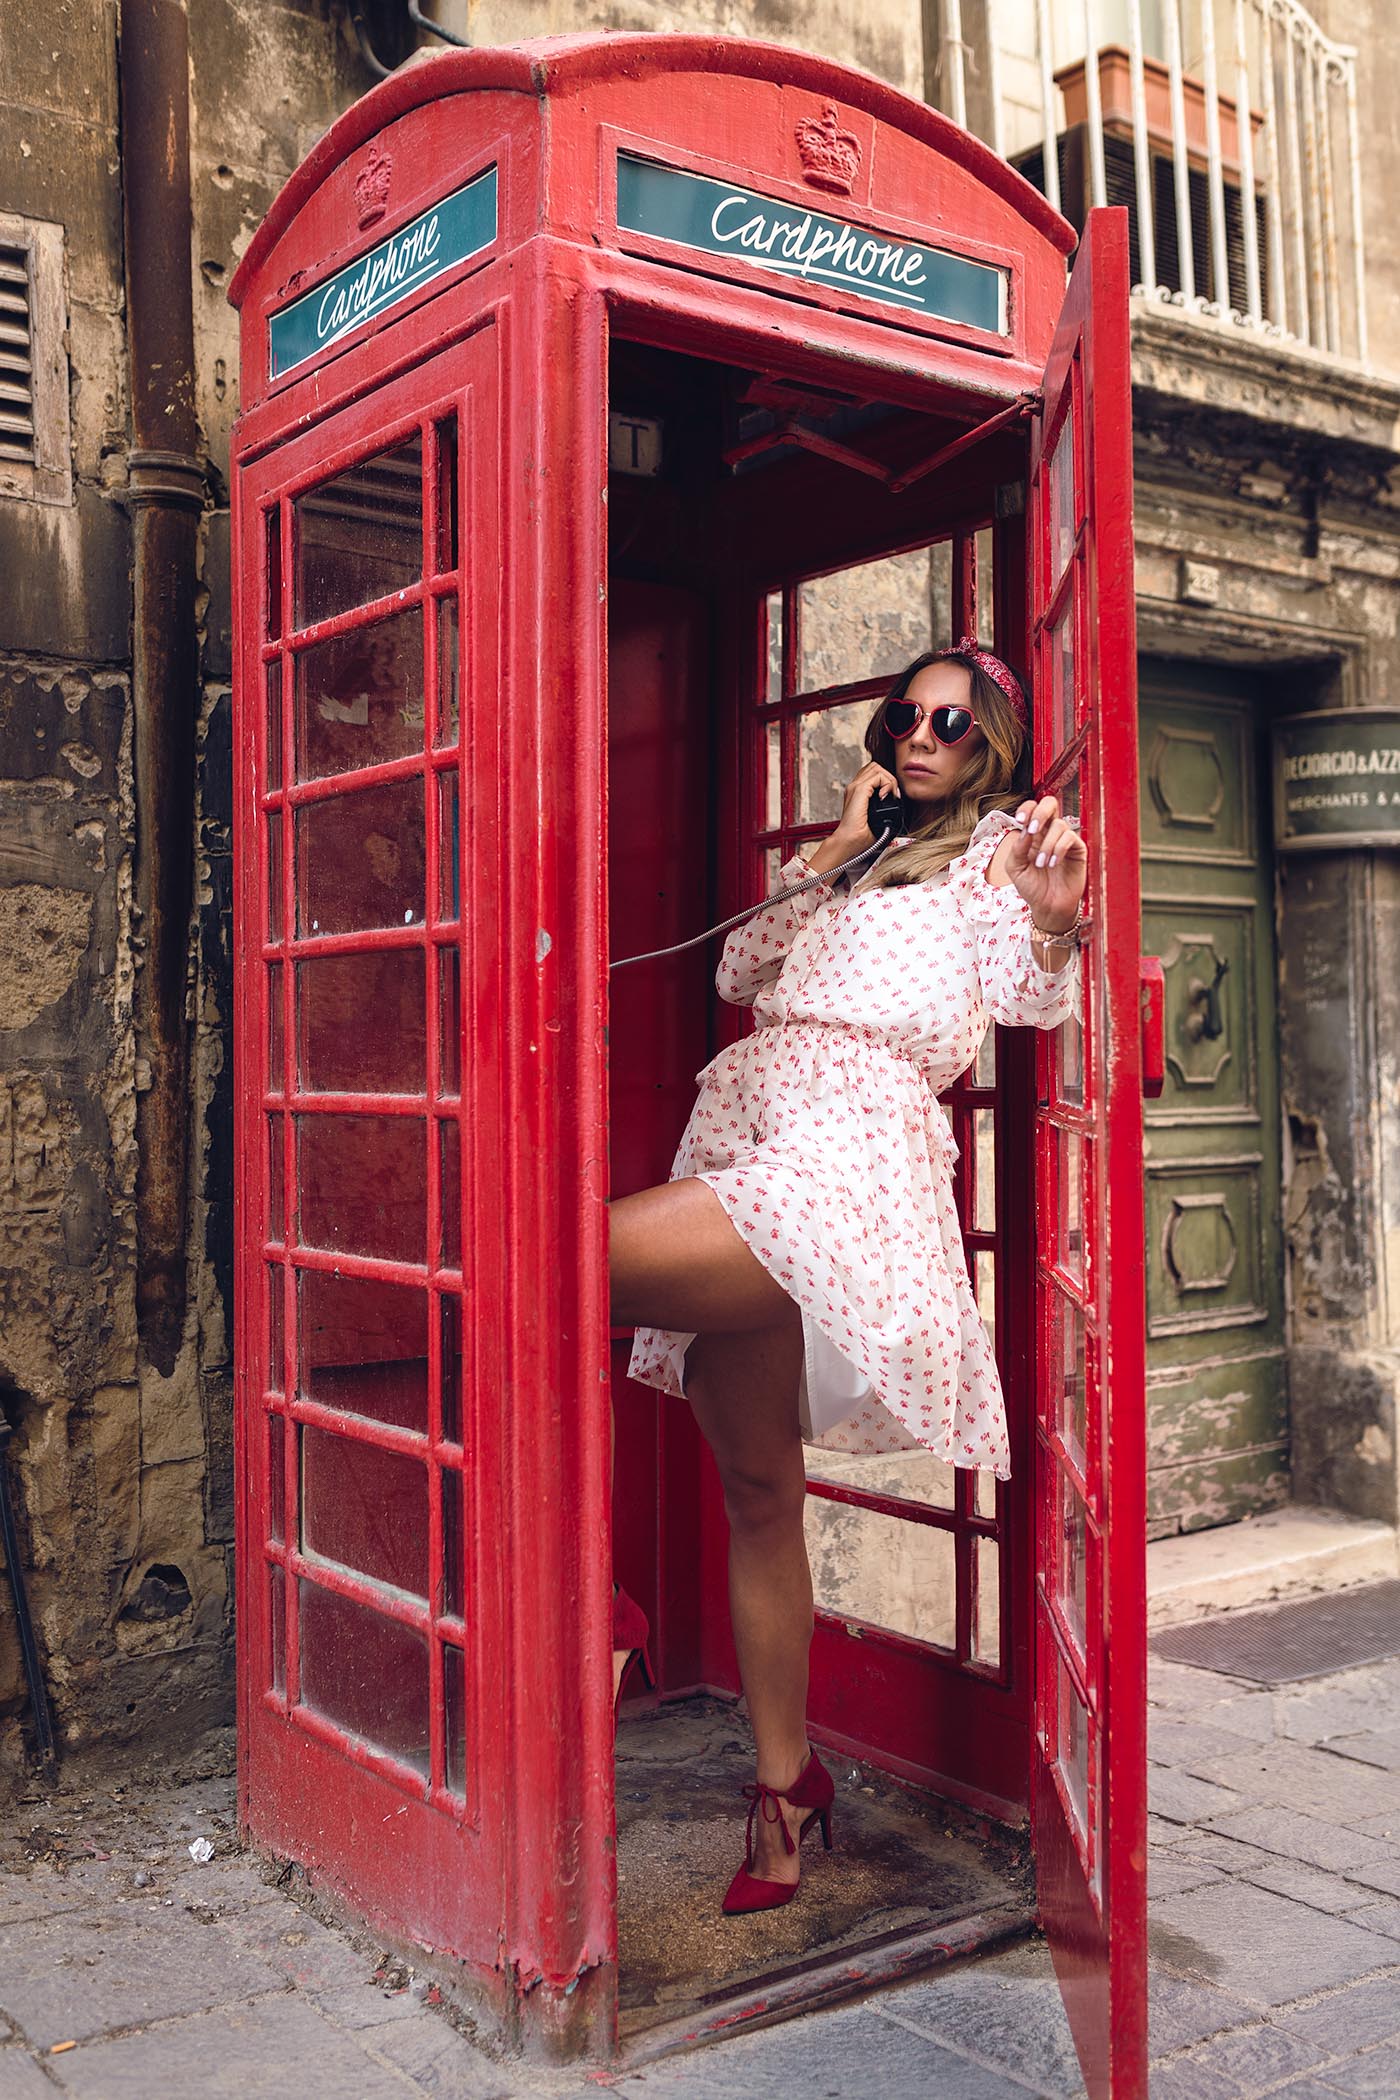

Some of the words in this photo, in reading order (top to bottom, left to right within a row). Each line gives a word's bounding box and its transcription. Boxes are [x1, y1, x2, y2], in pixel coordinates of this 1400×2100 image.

[711, 196, 928, 286] Cardphone
[317, 215, 441, 338] Cardphone
[1368, 749, 1400, 774] AZZ
[1287, 791, 1369, 812] MERCHANTS
[1376, 791, 1388, 807] &
